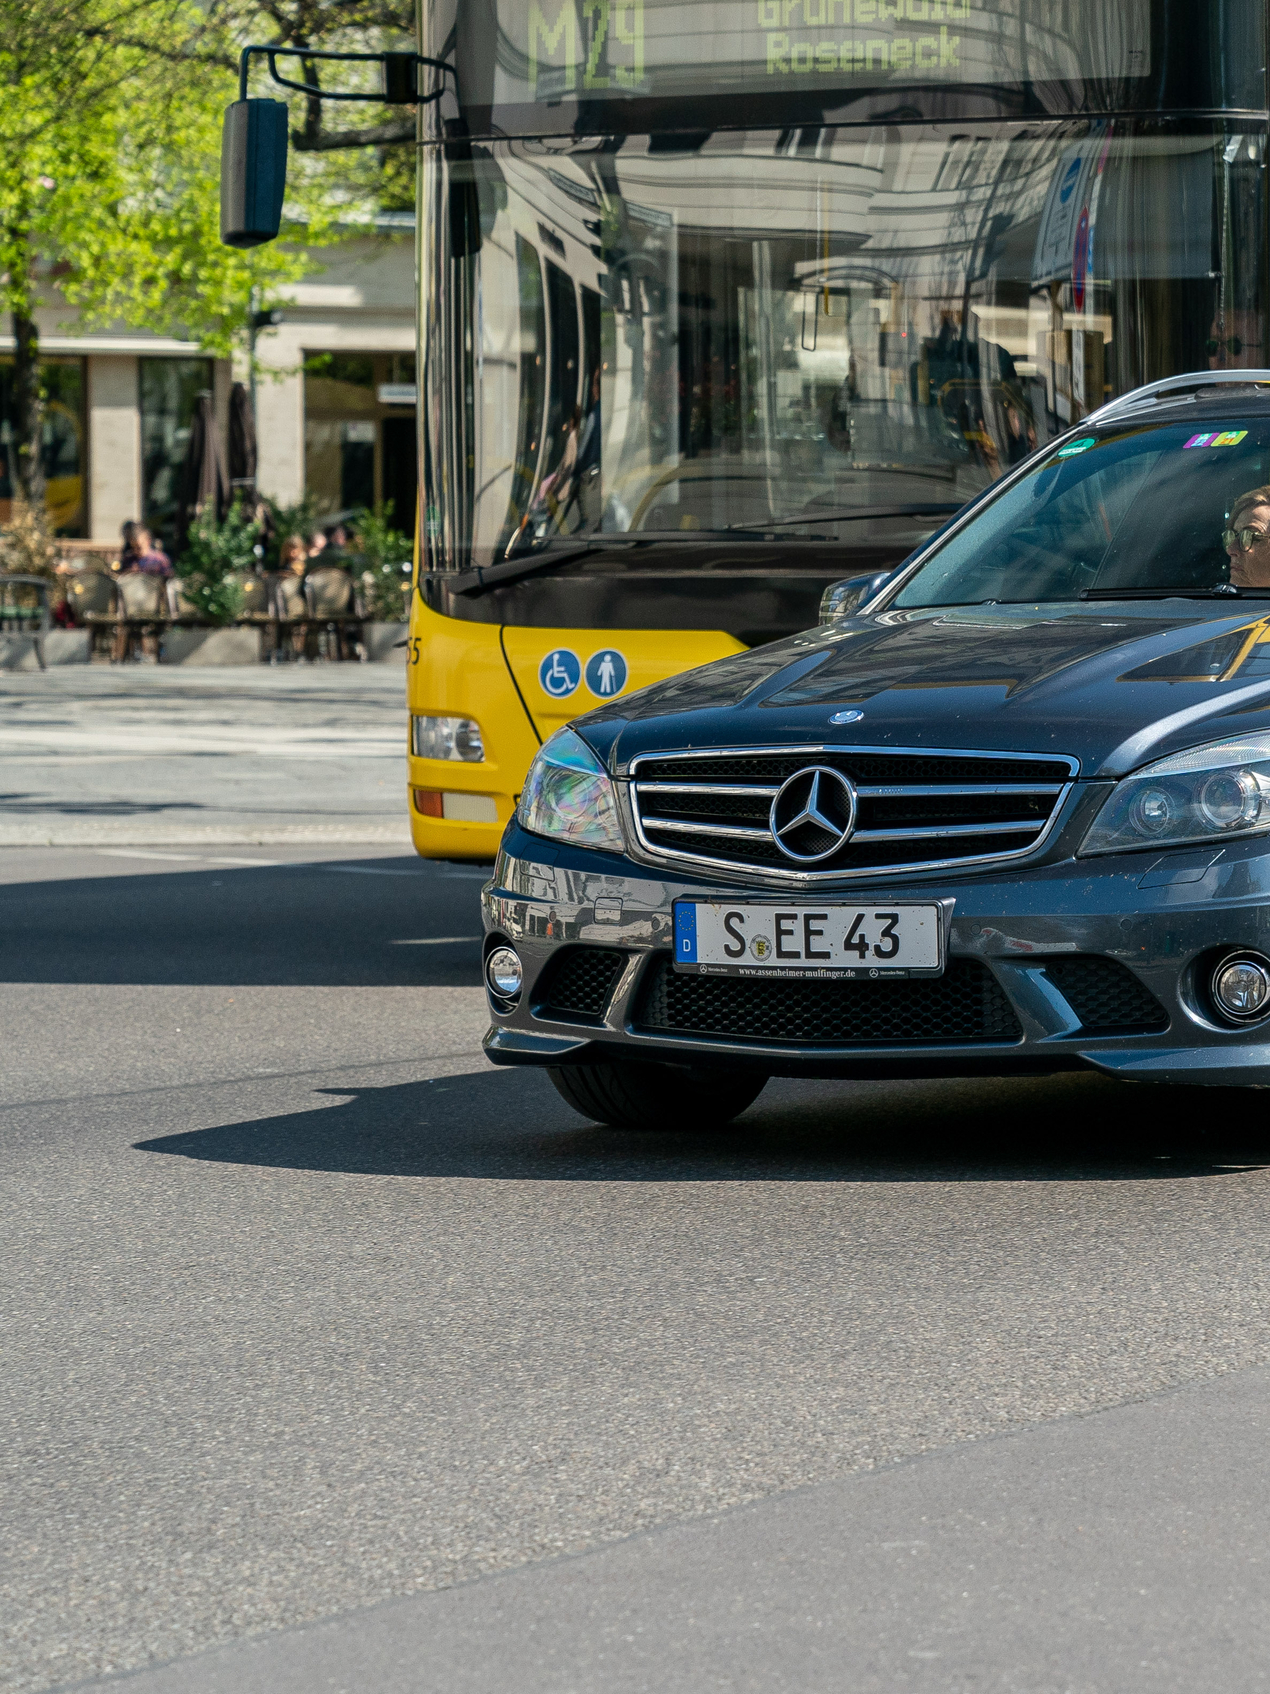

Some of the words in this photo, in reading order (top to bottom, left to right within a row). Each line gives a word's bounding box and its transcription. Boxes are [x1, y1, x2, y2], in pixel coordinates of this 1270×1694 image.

[528, 0, 644, 92] M29
[766, 25, 961, 75] Roseneck
[682, 938, 691, 952] D
[723, 910, 746, 959] S
[774, 912, 831, 959] EE
[843, 912, 900, 959] 43
[739, 967, 856, 979] www.assenheimer-mulfinger.de
